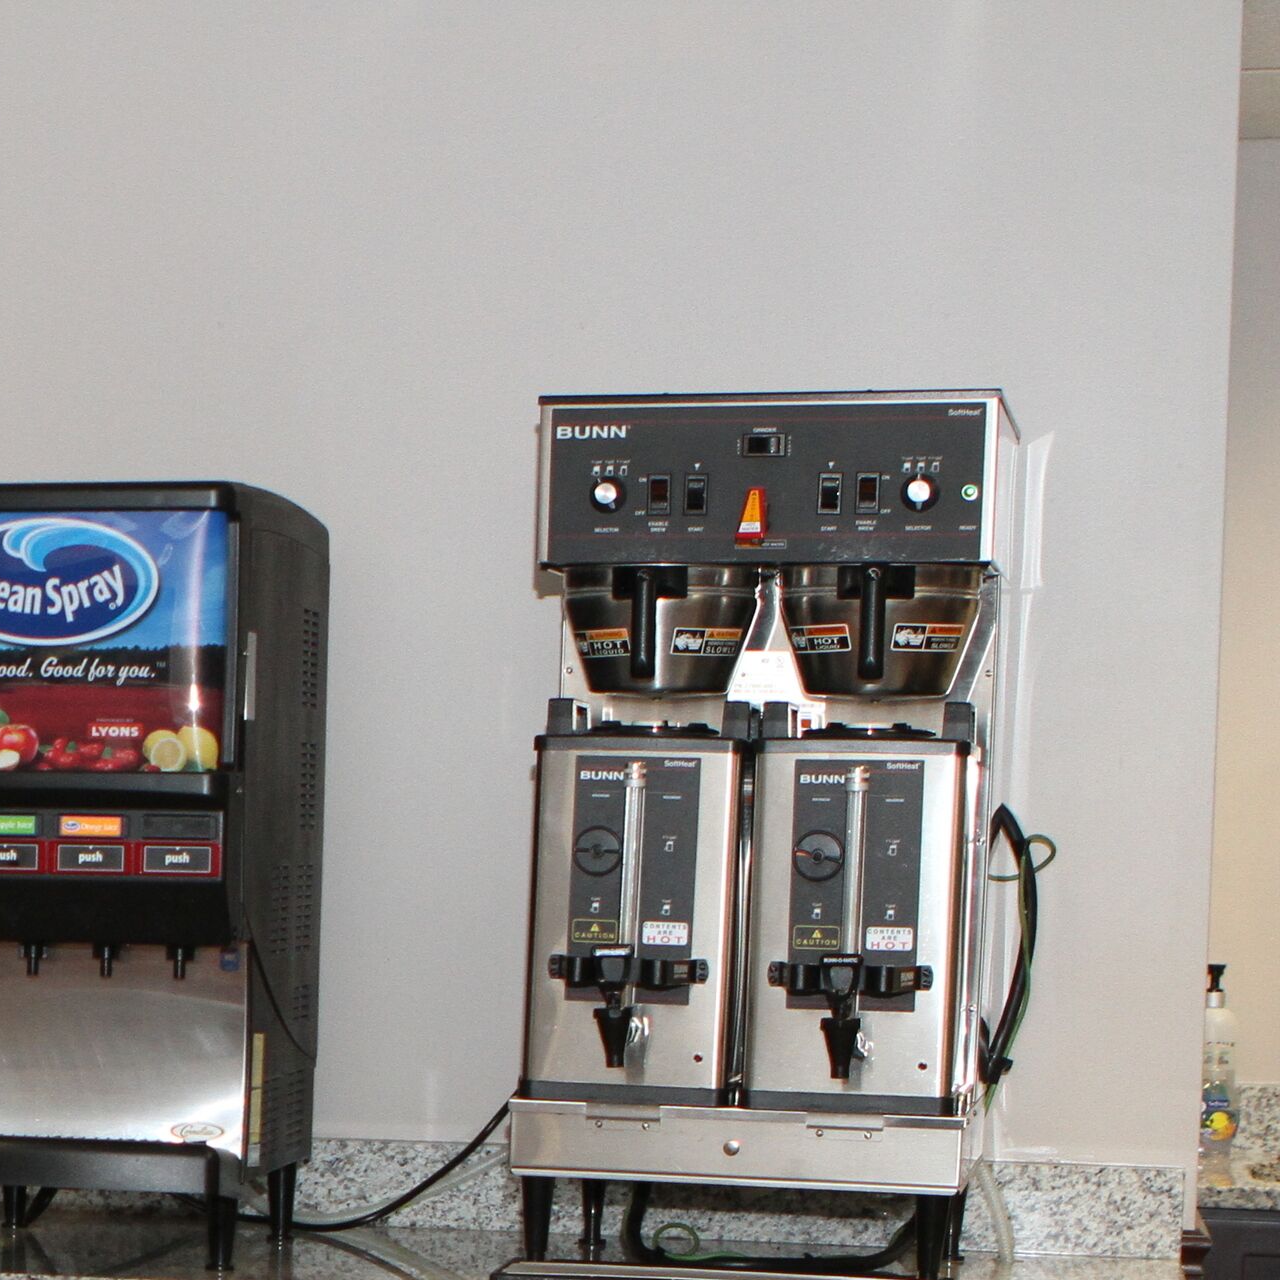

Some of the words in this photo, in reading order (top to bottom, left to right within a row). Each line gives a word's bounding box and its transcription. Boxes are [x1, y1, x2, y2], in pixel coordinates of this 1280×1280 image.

[556, 424, 627, 440] BUNN
[45, 564, 126, 623] Spray
[593, 640, 623, 649] HOT
[814, 637, 840, 645] HOT
[595, 648, 624, 656] LIQUID
[705, 645, 735, 654] SLOWLY
[40, 656, 85, 678] Good
[87, 657, 115, 682] for
[116, 663, 156, 686] you.
[91, 725, 140, 737] LYONS
[664, 760, 697, 768] SoftHeat
[886, 762, 920, 770] SoftHeat
[580, 770, 624, 781] BUNN
[800, 774, 845, 784] BUNN
[78, 851, 103, 864] push
[164, 852, 190, 866] push
[643, 922, 687, 930] CONTENTS
[574, 931, 615, 939] CAUTION
[646, 935, 683, 944] HOT
[795, 938, 838, 946] CAUTION
[870, 941, 909, 950] HOT
